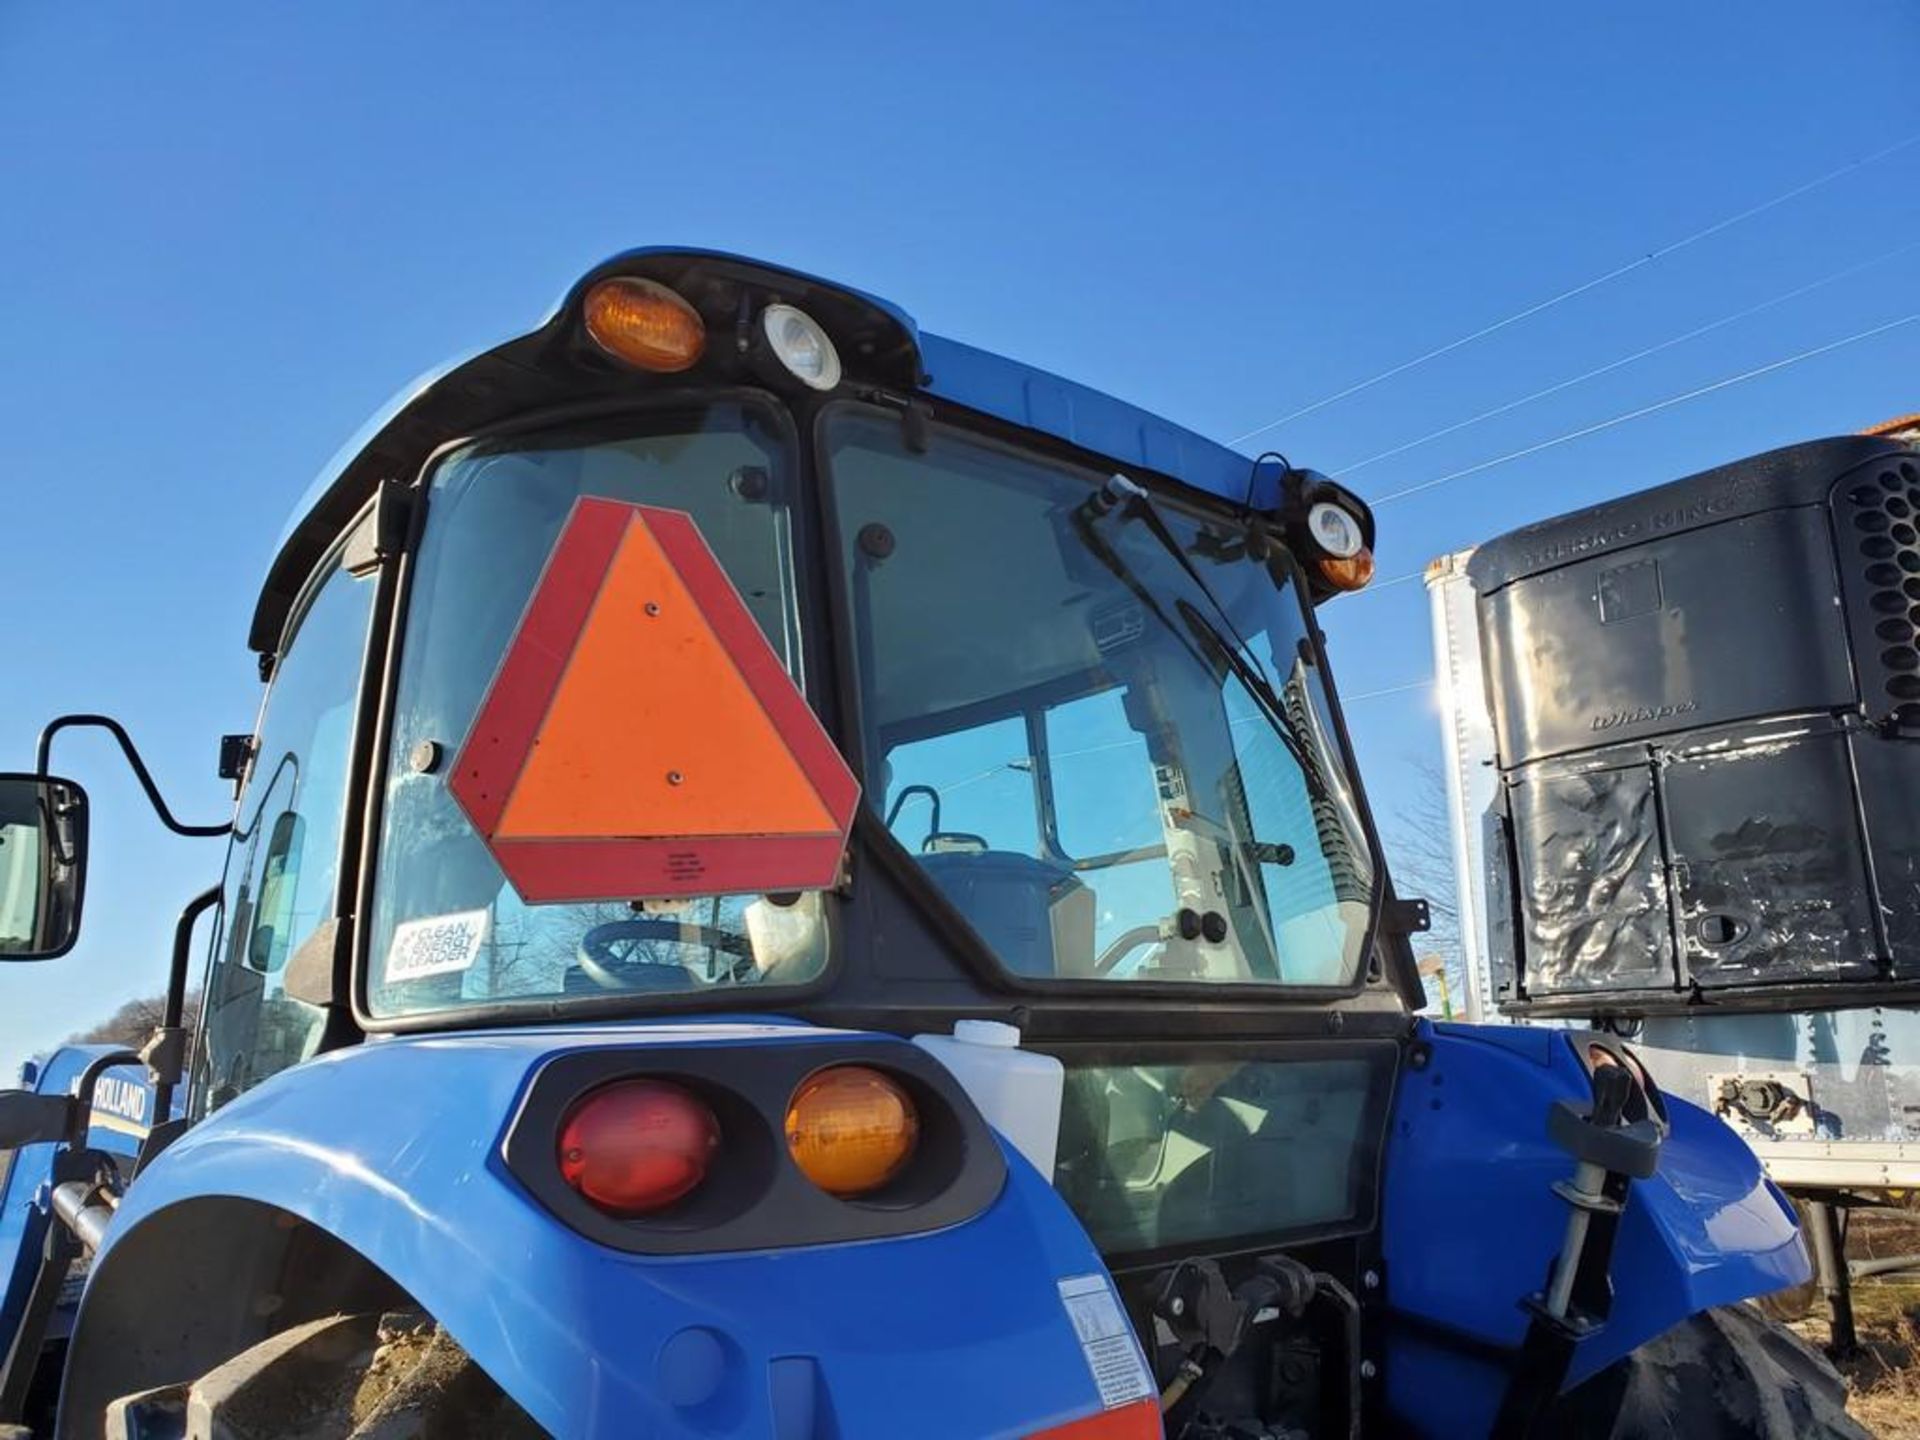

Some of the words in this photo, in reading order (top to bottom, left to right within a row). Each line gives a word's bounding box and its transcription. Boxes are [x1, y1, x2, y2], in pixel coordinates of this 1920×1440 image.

[417, 920, 470, 941] CLEAN
[411, 931, 478, 956] ENERGY
[408, 946, 471, 968] LEADER
[92, 1076, 146, 1121] HOLLAND
